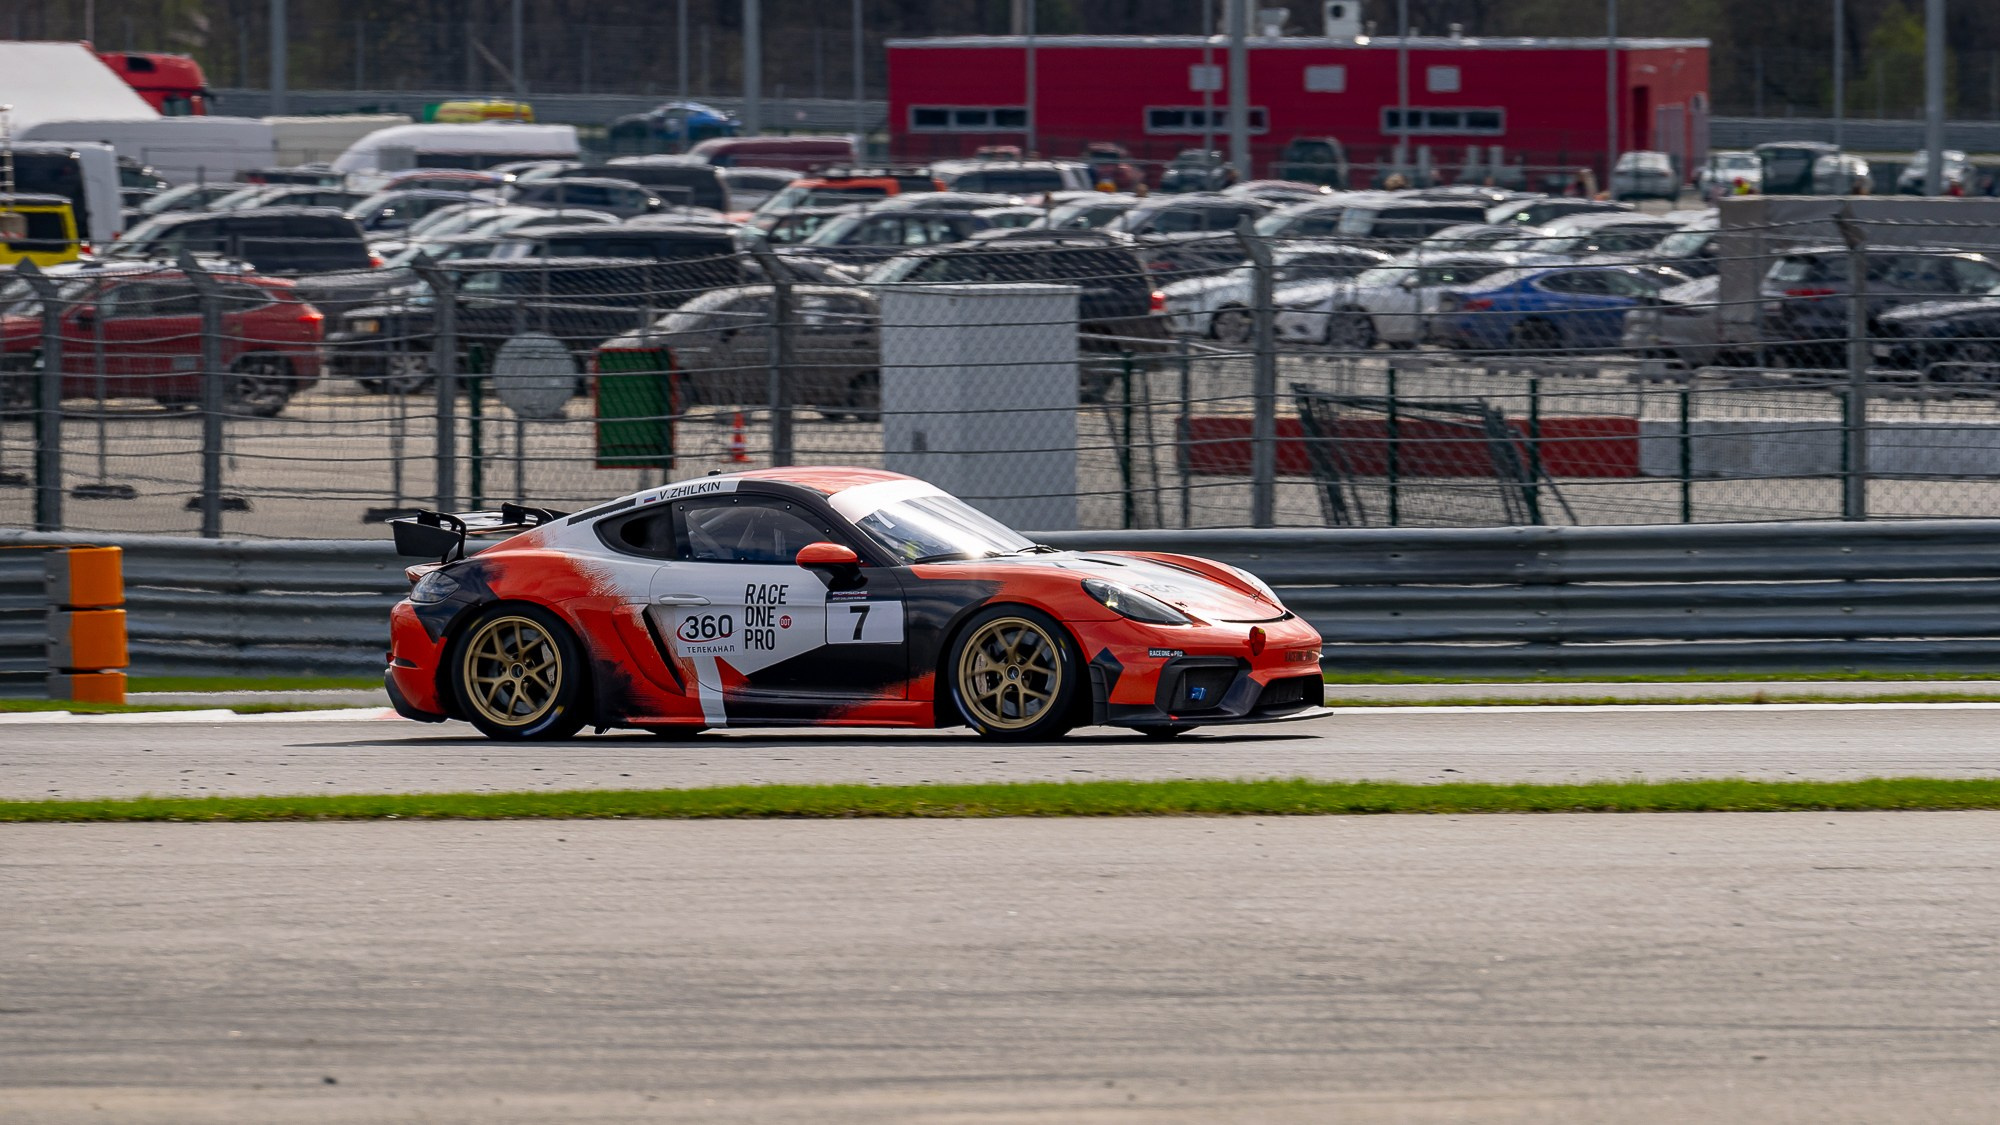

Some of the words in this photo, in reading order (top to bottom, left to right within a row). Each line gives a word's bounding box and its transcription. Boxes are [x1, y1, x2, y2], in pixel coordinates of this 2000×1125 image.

[659, 481, 721, 500] V.ZHILKIN
[745, 583, 789, 605] RACE
[685, 614, 733, 640] 360
[745, 605, 776, 628] ONE
[849, 605, 870, 641] 7
[686, 645, 735, 654] ТЕЛЕКАНАЛ
[745, 628, 775, 650] PRO
